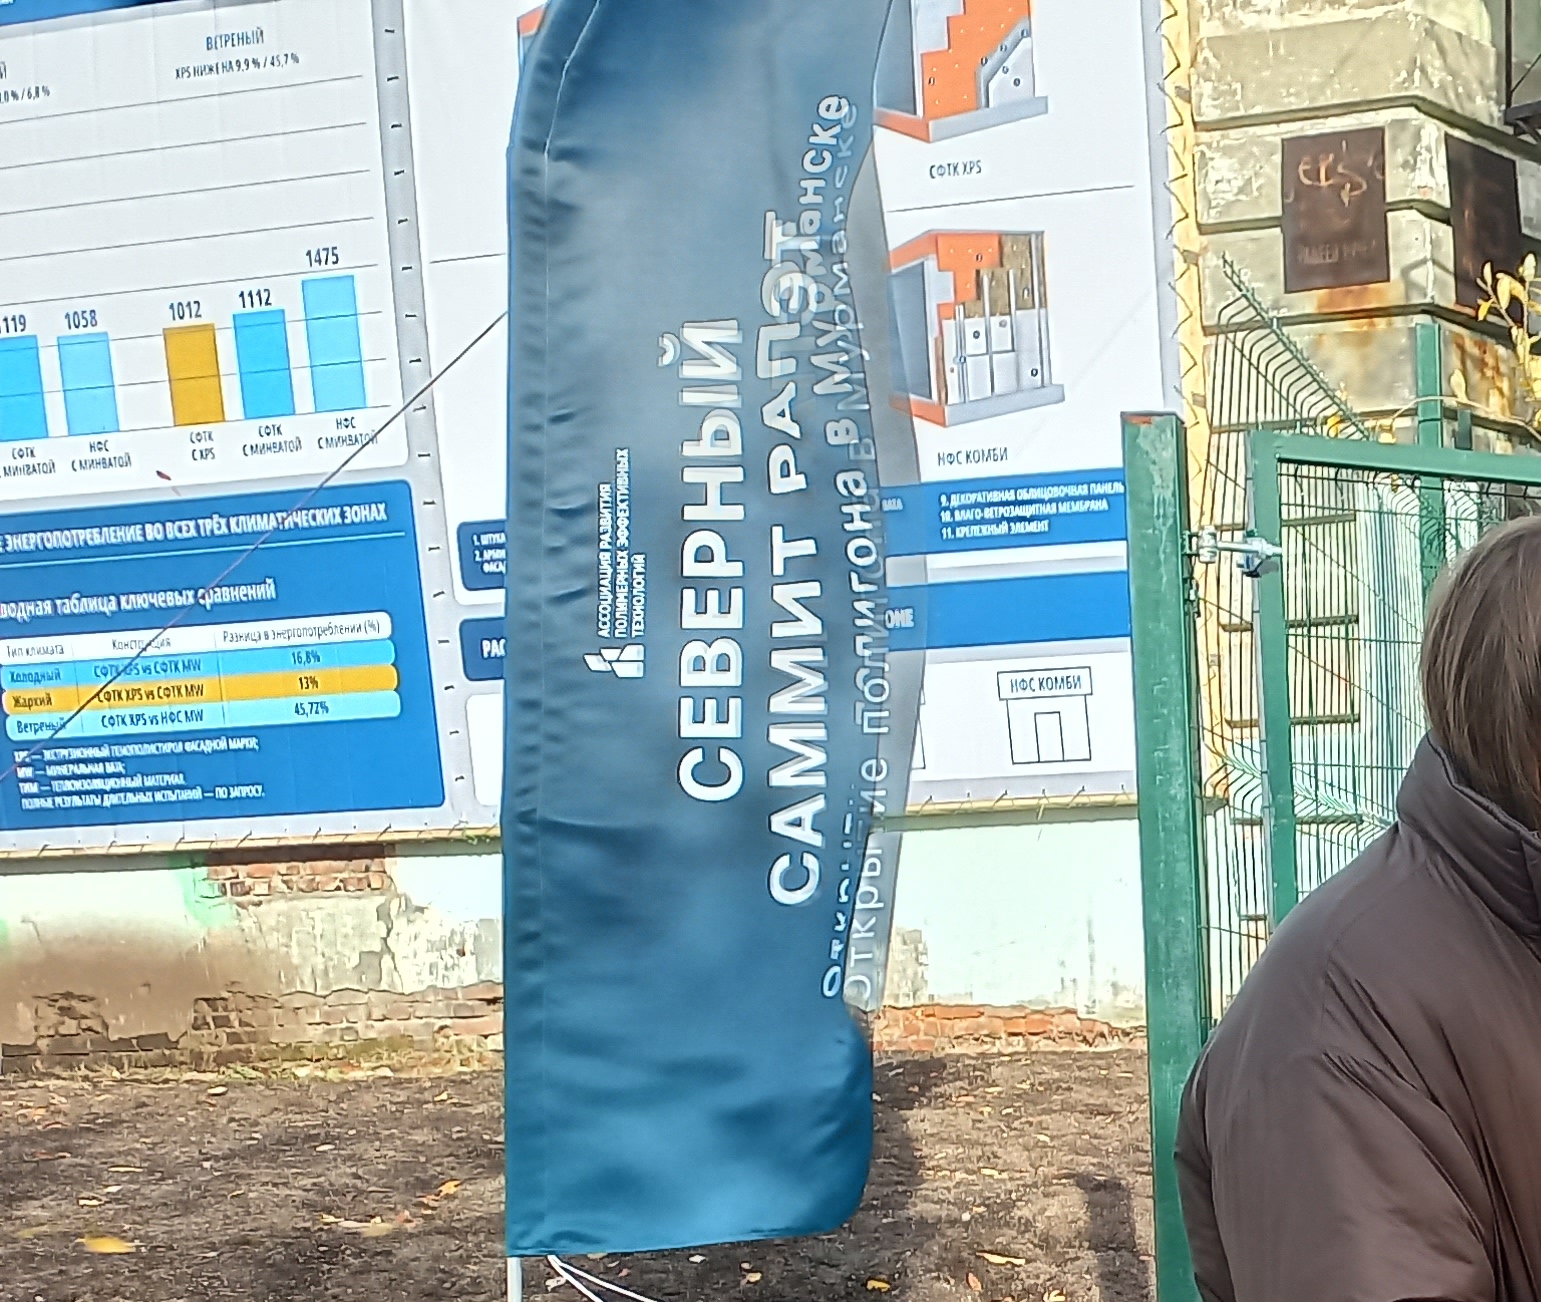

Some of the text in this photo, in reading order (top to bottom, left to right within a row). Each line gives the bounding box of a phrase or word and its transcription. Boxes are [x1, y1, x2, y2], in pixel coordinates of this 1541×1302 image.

[206, 26, 264, 51] ВЕТРЕНЫЙ
[221, 60, 234, 73] НА
[962, 159, 982, 175] XPS
[305, 246, 340, 267] 1475
[238, 288, 272, 308] 1112
[64, 309, 98, 330] 1058
[168, 300, 202, 321] 1012
[966, 447, 1008, 465] КОМБИ
[5, 523, 145, 552] ЭНЕРГОПОТРЕБЛЕНИЕ
[145, 523, 164, 541] ВО
[165, 518, 197, 540] ВСЕХ
[198, 514, 229, 537] ТРЁХ
[230, 507, 342, 534] КЛИМАТИЧЕСКИХ
[343, 502, 387, 524] ЗОНАХ
[658, 318, 745, 803] СЕВЕРНЫЙ
[756, 211, 826, 907] САММИТ РАПЭТ
[56, 593, 118, 618] таблица
[120, 588, 195, 611] ключевых
[197, 577, 277, 610] сравнений
[598, 554, 614, 638] АССОЦИАЦИЯ
[291, 650, 321, 666] 16,8%
[298, 675, 319, 690] 13%
[1010, 675, 1082, 693] НФС КОМБИ
